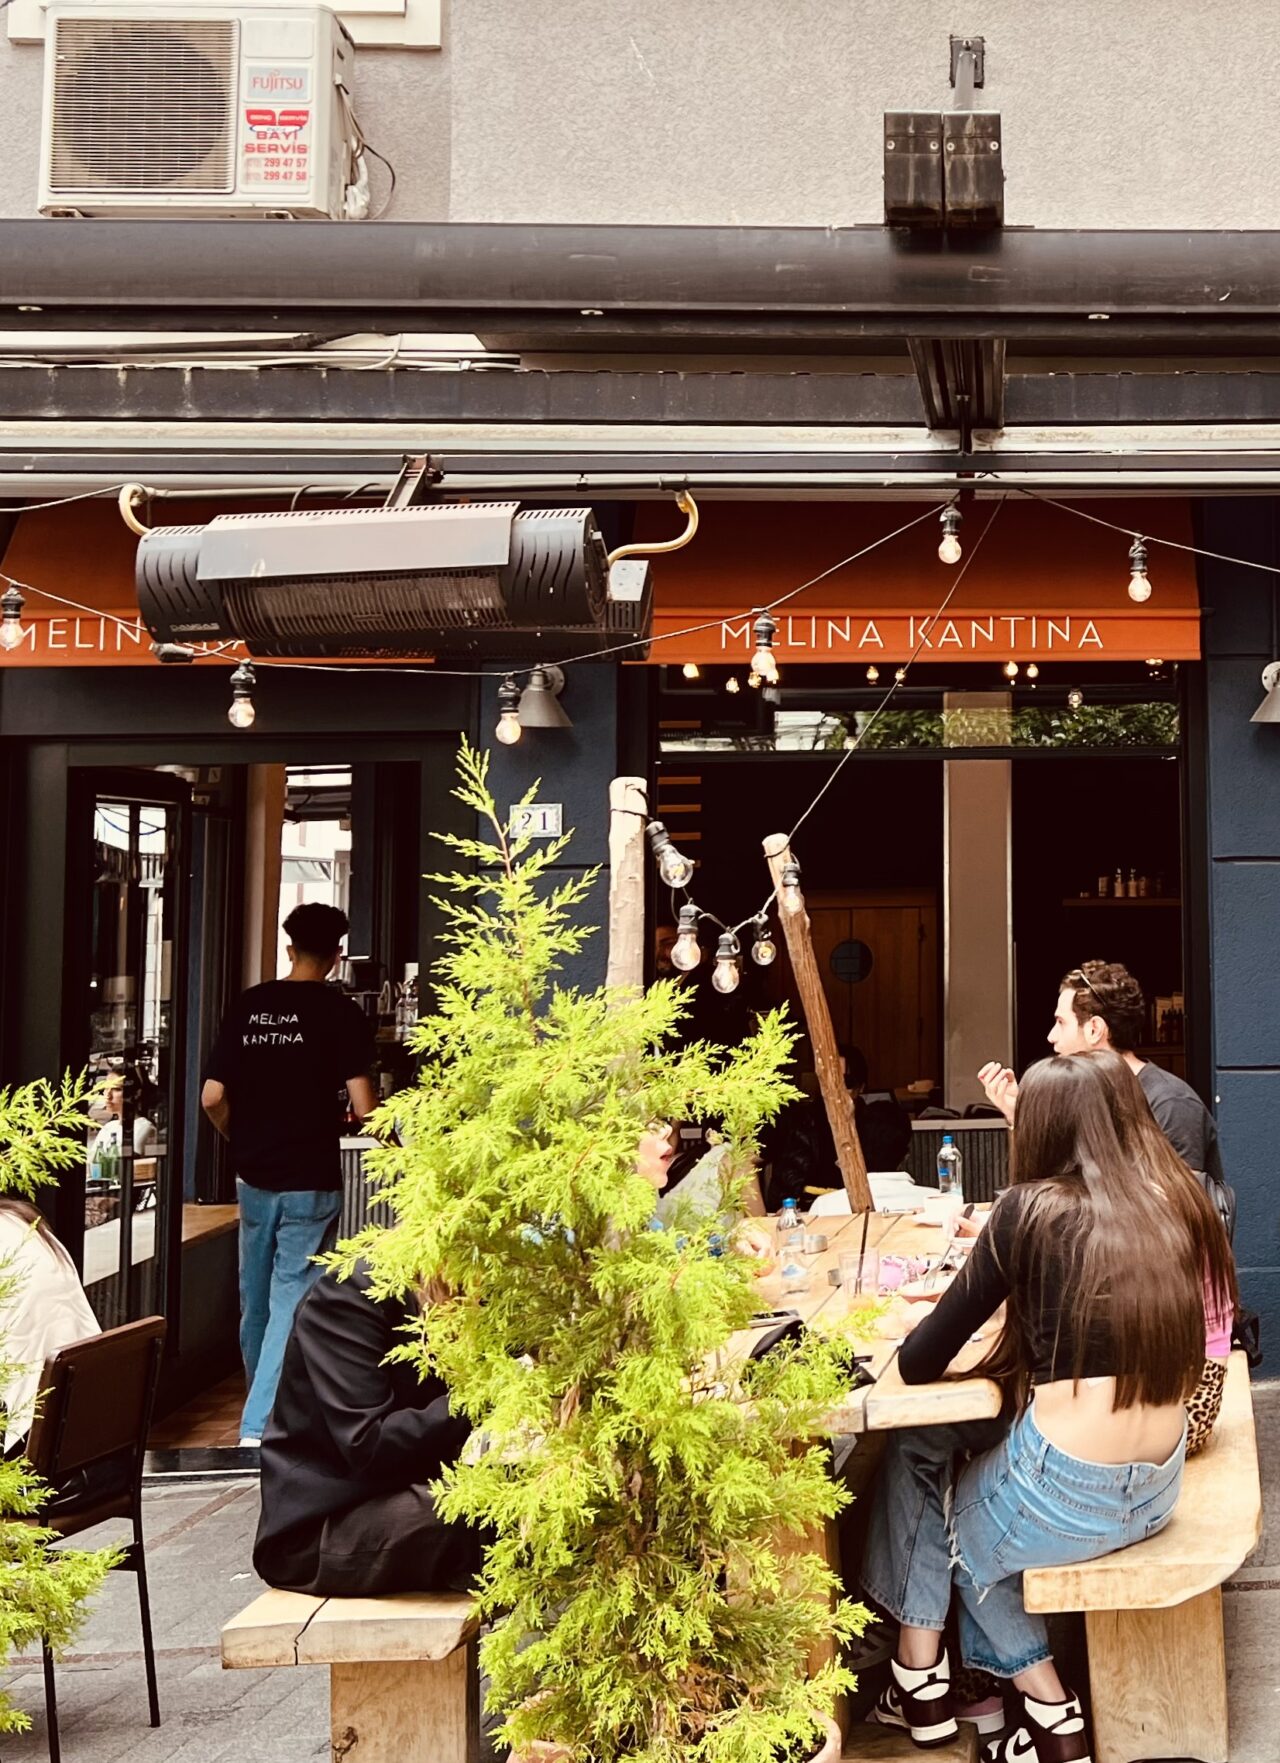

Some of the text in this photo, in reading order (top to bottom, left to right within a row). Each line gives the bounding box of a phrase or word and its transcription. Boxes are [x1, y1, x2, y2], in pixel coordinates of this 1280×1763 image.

[252, 71, 303, 92] FUJITSU
[245, 142, 308, 154] SERVİS
[264, 157, 281, 168] 299
[283, 158, 295, 168] 47
[296, 158, 308, 168] 57
[263, 171, 281, 181] 299
[282, 171, 294, 181] 47
[296, 172, 307, 181] 58
[6, 616, 154, 651] ELIN
[909, 615, 1104, 649] KANTINA
[521, 810, 547, 831] 21
[249, 1013, 299, 1026] MELINA
[243, 1032, 304, 1047] KANTINA
